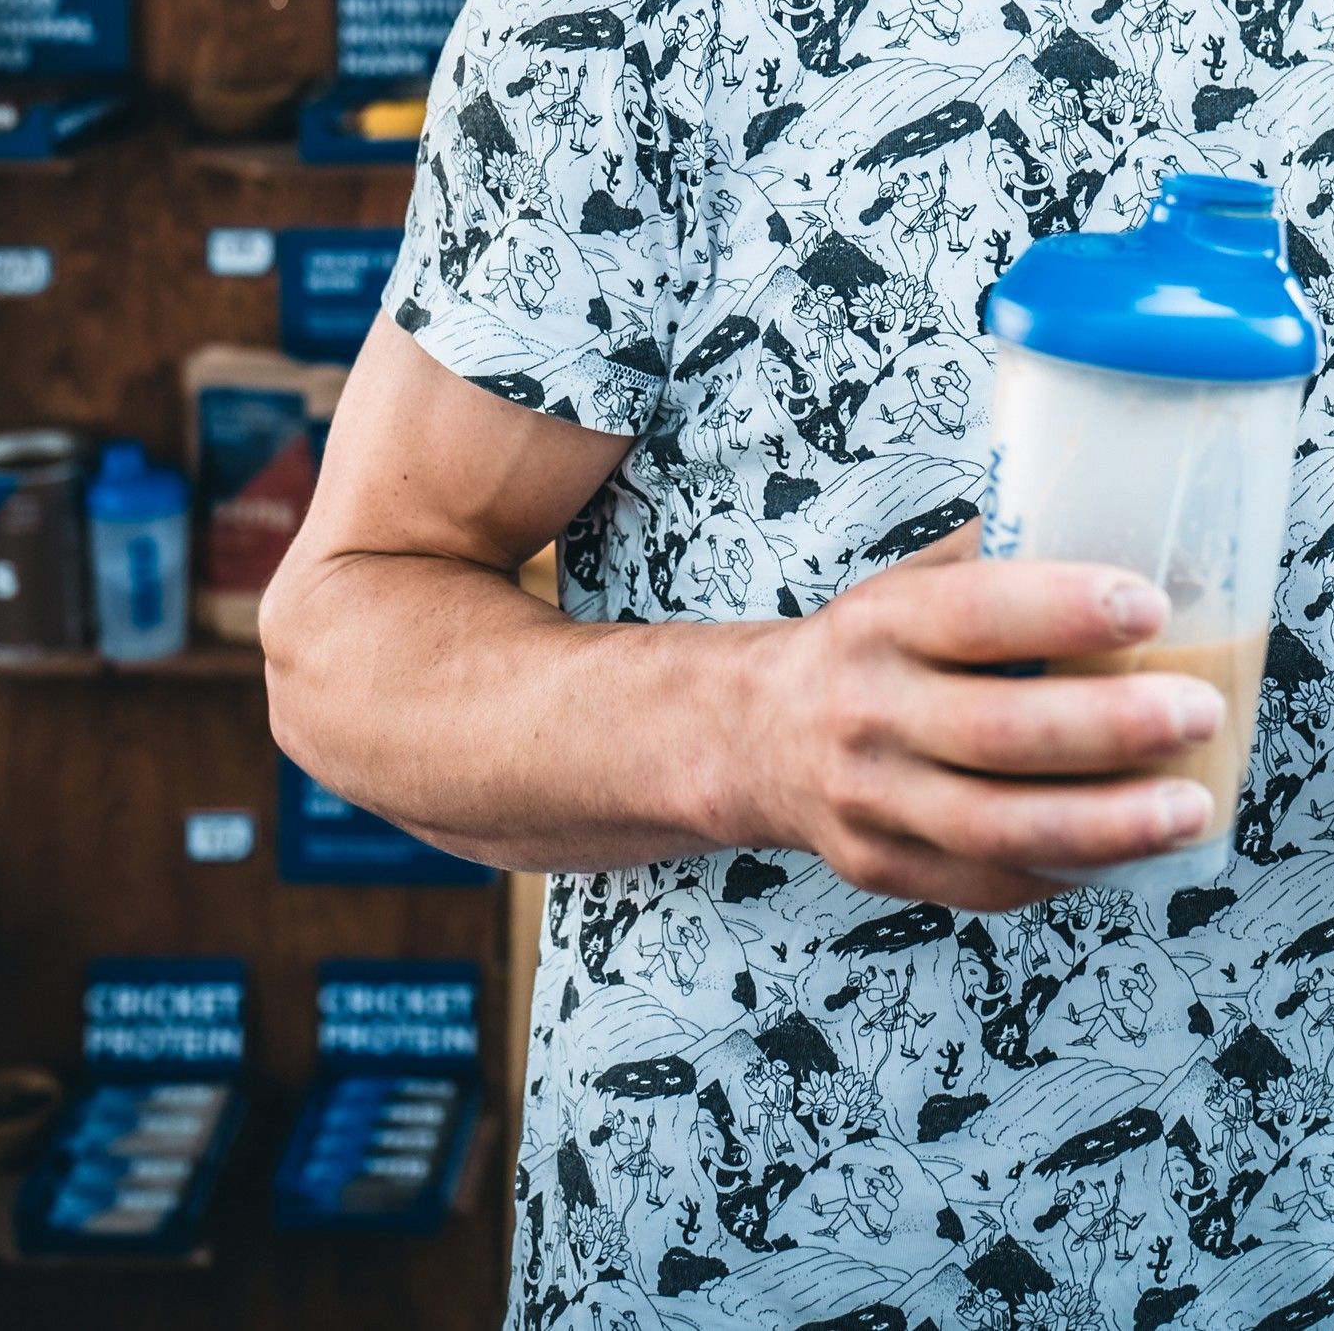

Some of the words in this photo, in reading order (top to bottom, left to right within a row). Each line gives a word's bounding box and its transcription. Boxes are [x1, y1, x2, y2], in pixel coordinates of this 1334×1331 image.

[84, 983, 240, 1017] CRICKET
[318, 982, 473, 1016] CRICKET
[83, 1026, 244, 1060] PROTEIN
[318, 1023, 479, 1055] PROTEIN
